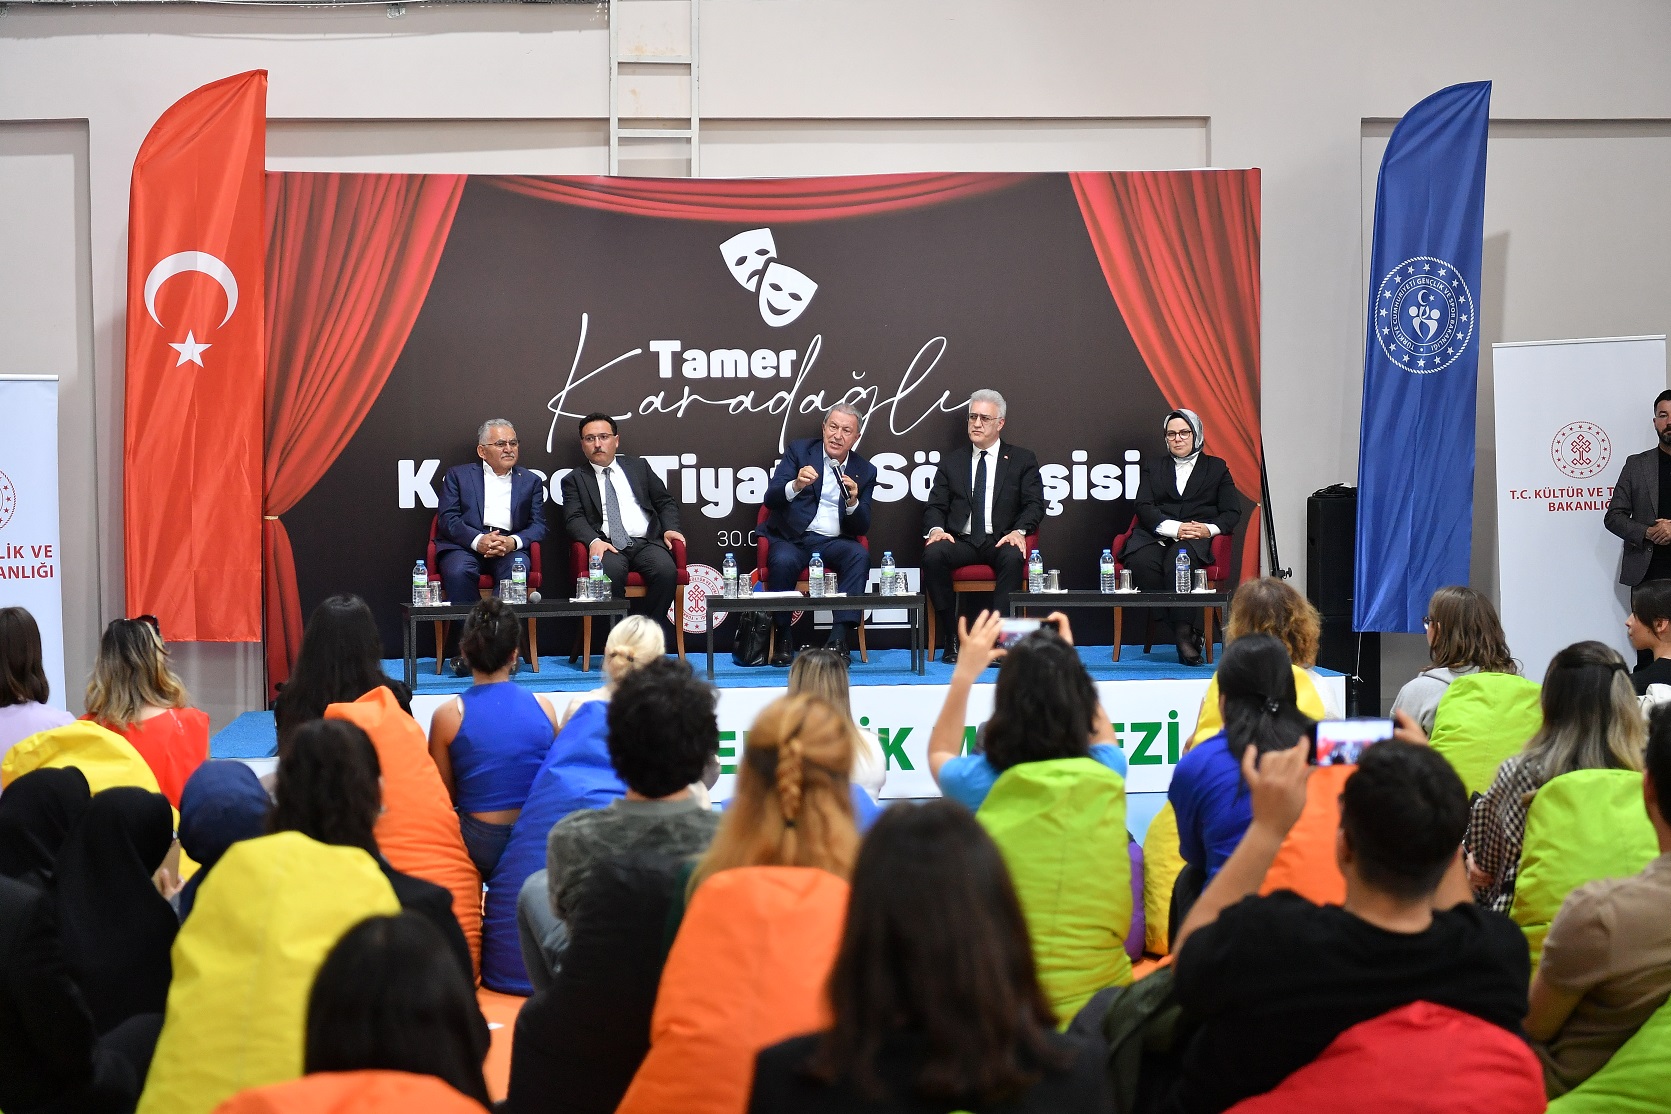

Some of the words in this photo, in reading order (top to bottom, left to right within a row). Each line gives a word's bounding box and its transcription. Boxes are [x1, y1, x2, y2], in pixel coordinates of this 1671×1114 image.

[1416, 277, 1445, 291] GENÇLİK
[1444, 288, 1452, 298] VE
[1393, 278, 1416, 325] CUMHURİYETİ
[1394, 325, 1415, 351] TÜRKİYE
[1431, 319, 1456, 351] BAKANLIĞI
[649, 339, 797, 379] Tamer
[547, 312, 972, 453] Karadağlı
[1509, 489, 1531, 500] T.C.
[1534, 486, 1584, 499] KÜLTÜR
[1587, 487, 1604, 497] VE
[31, 544, 53, 559] VE
